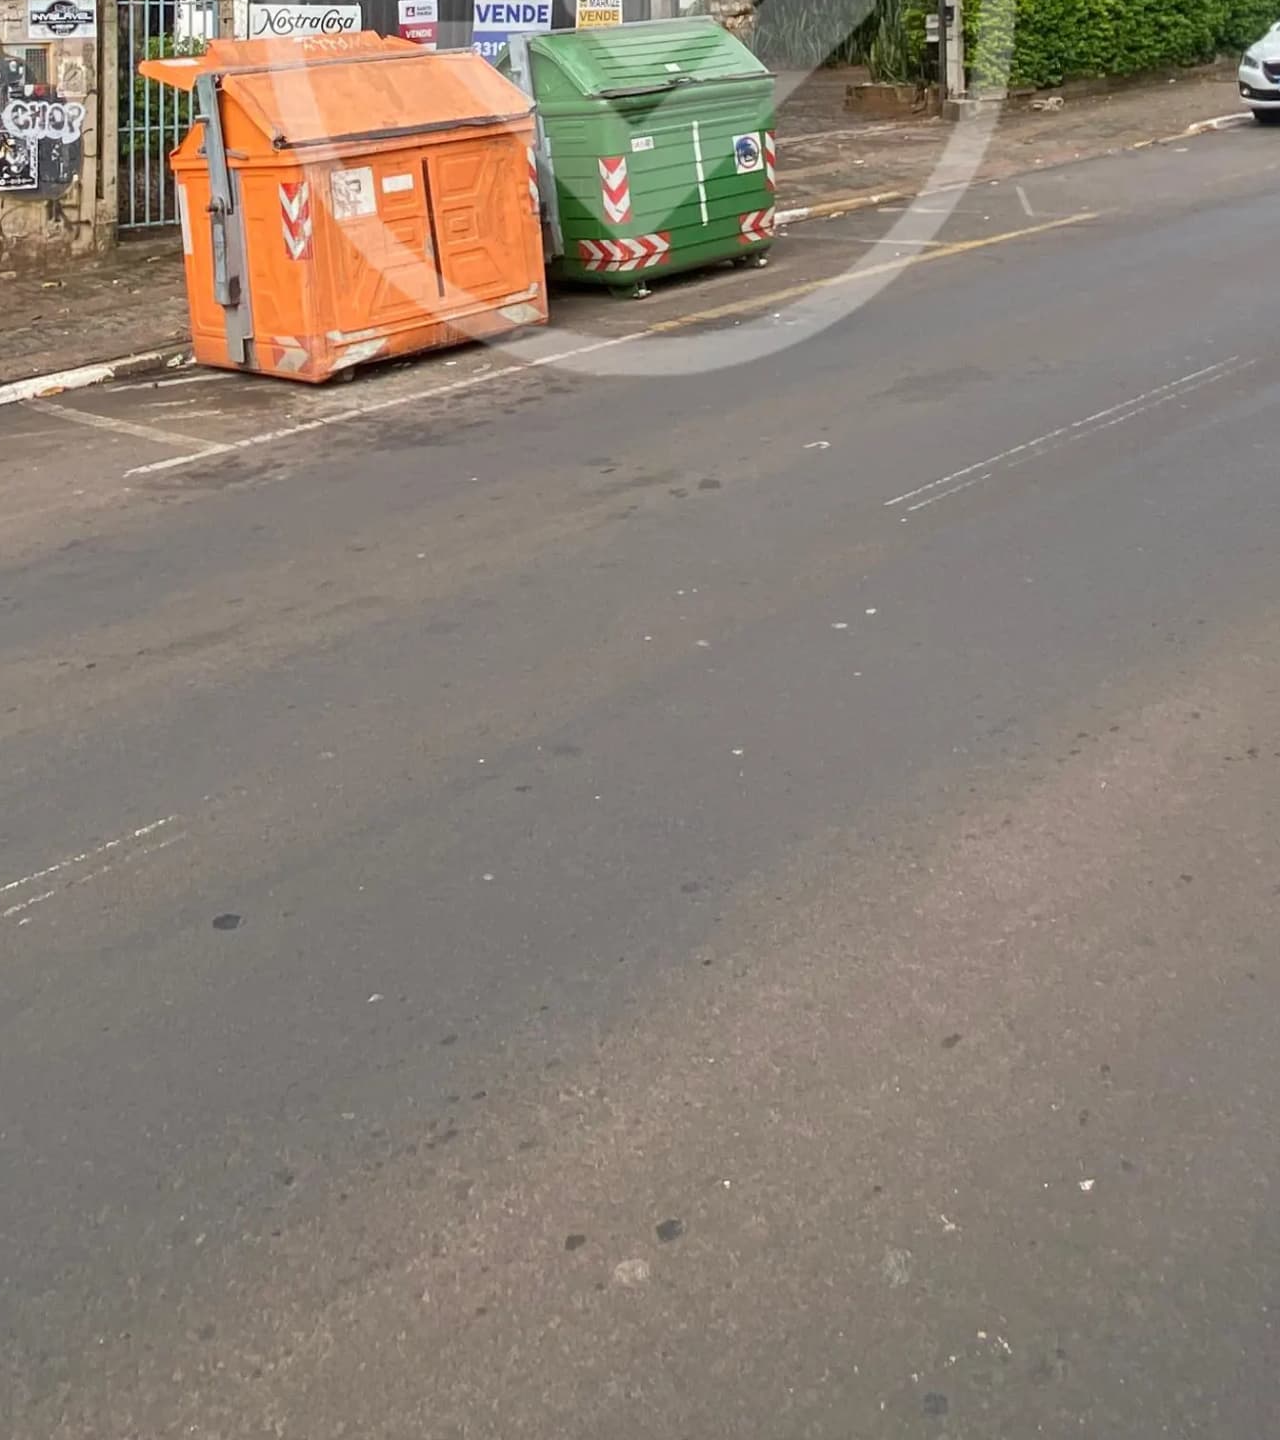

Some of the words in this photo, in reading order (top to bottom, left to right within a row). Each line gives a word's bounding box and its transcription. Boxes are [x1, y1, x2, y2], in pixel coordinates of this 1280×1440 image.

[476, 4, 549, 23] VENDE
[579, 10, 619, 21] VENDE
[405, 28, 433, 39] VENDE
